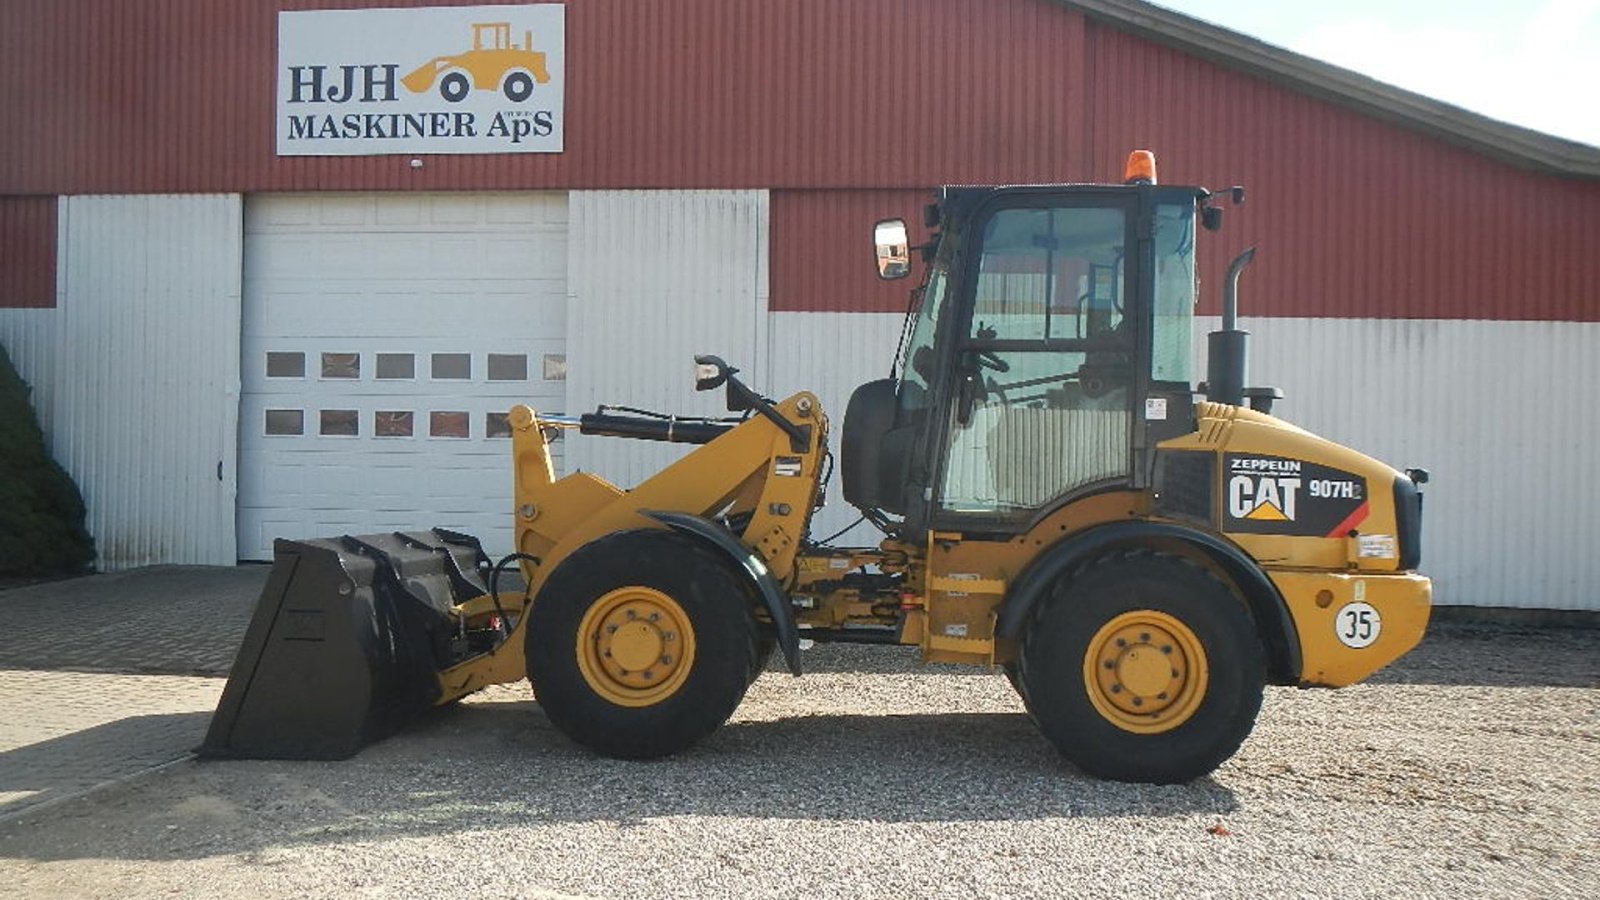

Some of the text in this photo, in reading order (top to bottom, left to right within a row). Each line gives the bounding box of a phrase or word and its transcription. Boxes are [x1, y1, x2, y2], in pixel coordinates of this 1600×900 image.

[287, 64, 399, 103] HJH
[287, 110, 553, 143] MASKINER ApS
[1231, 459, 1301, 472] ZEPPELIN
[1229, 475, 1301, 521] CAT
[1345, 611, 1372, 640] 35
